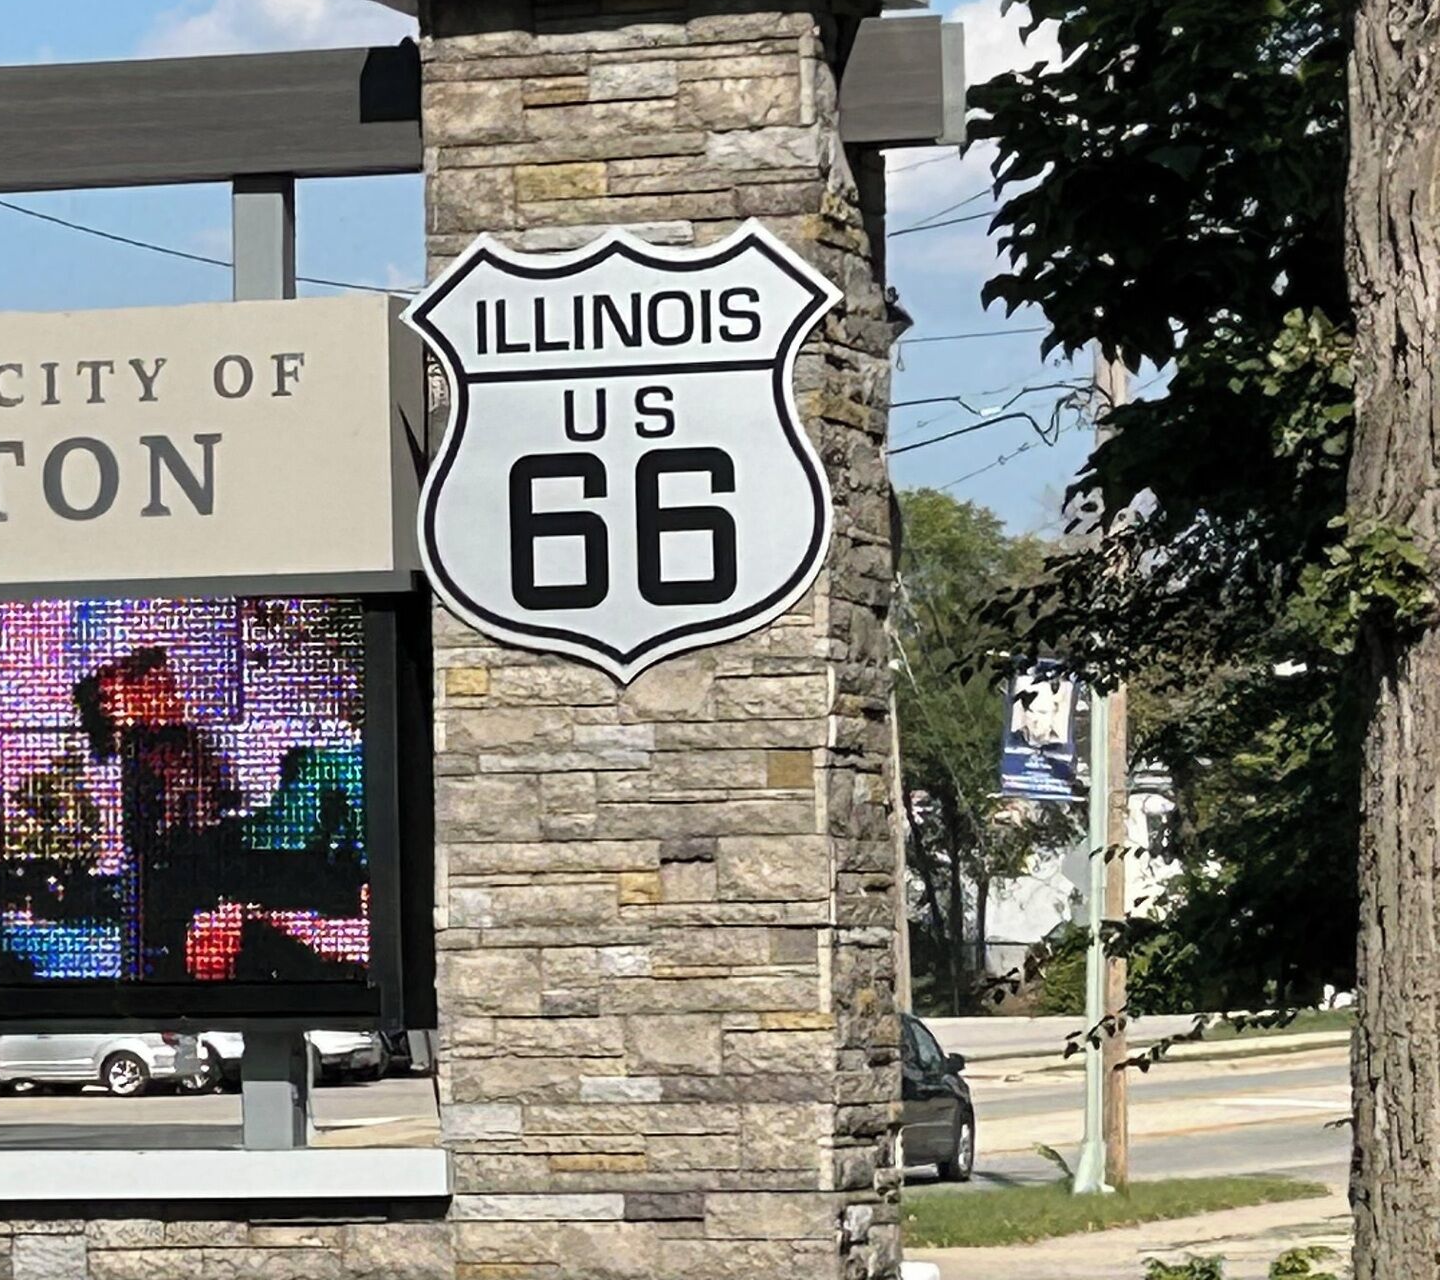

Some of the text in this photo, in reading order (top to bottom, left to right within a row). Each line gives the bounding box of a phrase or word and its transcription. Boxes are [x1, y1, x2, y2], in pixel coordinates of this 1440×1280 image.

[476, 287, 762, 355] ILLINOIS
[213, 352, 308, 400] OF
[509, 446, 738, 611] 66
